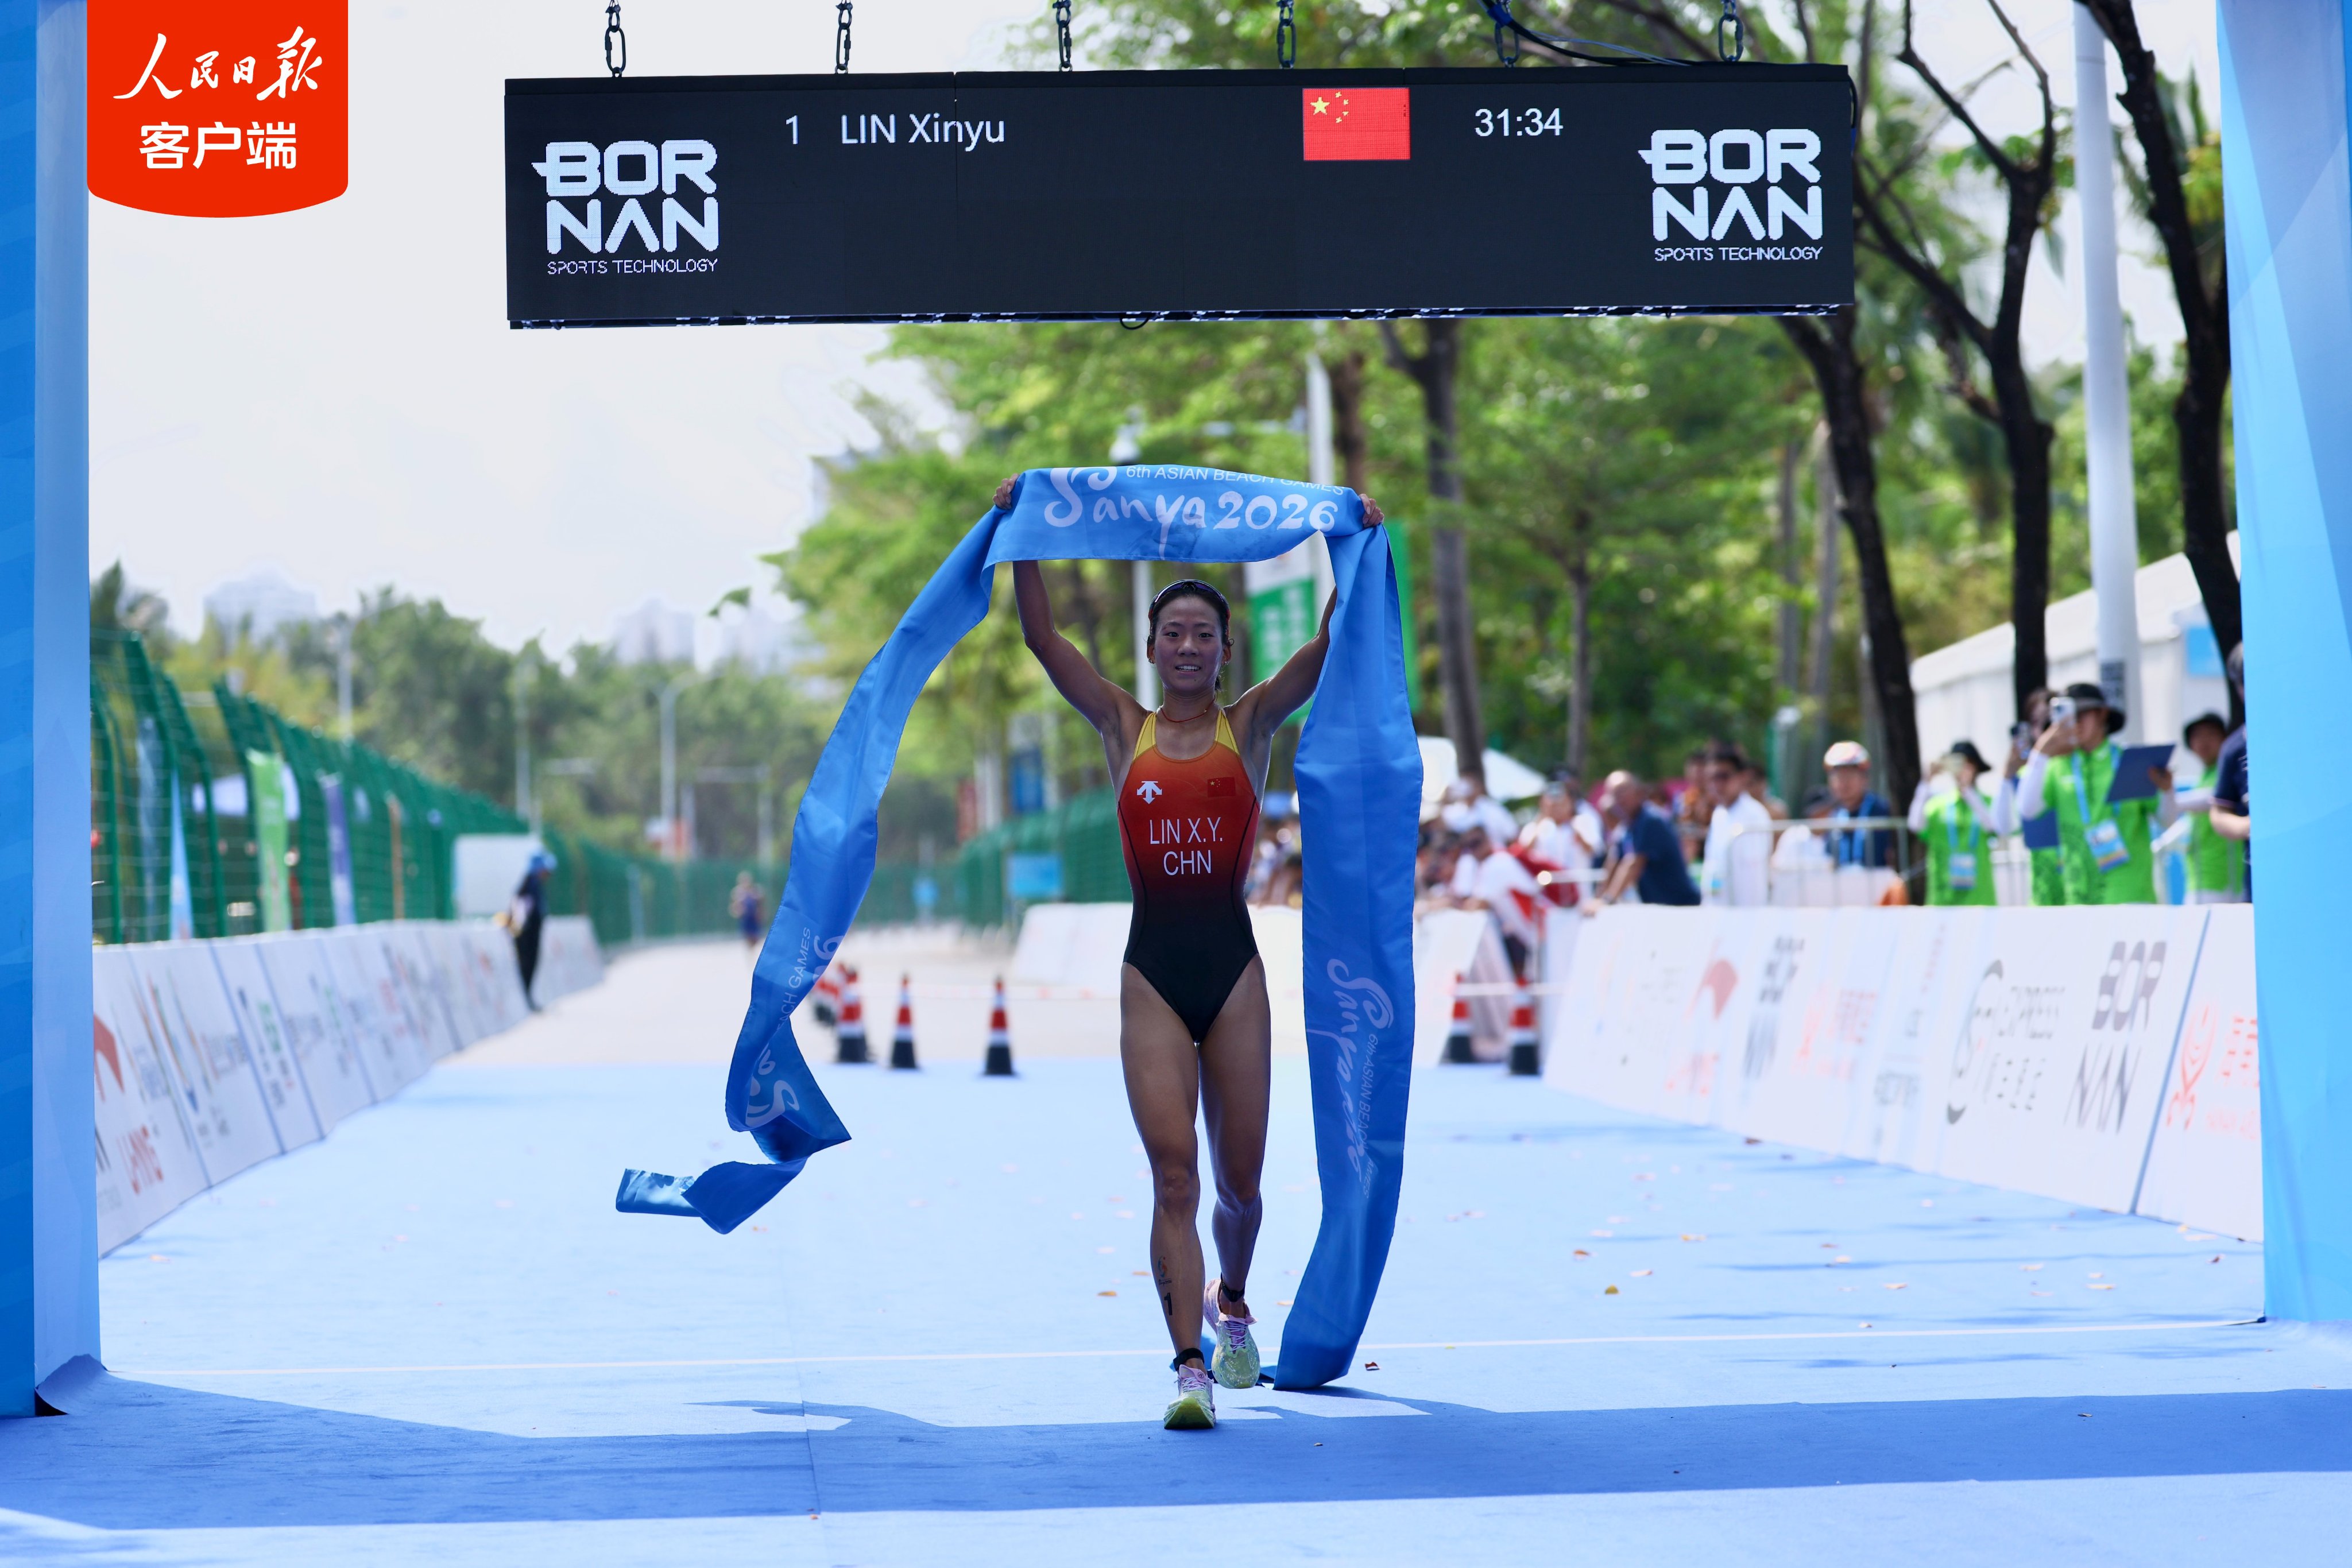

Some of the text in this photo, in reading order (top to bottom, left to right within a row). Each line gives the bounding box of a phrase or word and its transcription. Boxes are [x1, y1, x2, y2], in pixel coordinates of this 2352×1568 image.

[786, 113, 1004, 152] 1 LIN Xinyu
[1475, 108, 1564, 137] 31:34
[532, 140, 718, 196] BOR
[1638, 129, 1821, 184] BOR
[546, 196, 719, 255] NAN
[1652, 185, 1823, 241] NAN
[547, 258, 718, 275] SPORTS TECHNOLOGY
[1654, 246, 1823, 261] SPORTS TECHNOLOGY
[1126, 466, 1150, 478] 6th
[1154, 466, 1209, 481] ASIAN
[1044, 466, 1339, 560] Sanya 2026
[1150, 817, 1223, 845] LIN X.Y.
[1163, 850, 1212, 876] CHN
[788, 927, 811, 989] GAMES
[2091, 940, 2168, 1032] BOR
[1306, 958, 1394, 1082] Sanya
[1360, 1058, 1374, 1099] ASIAN
[1163, 1292, 1173, 1318] 1
